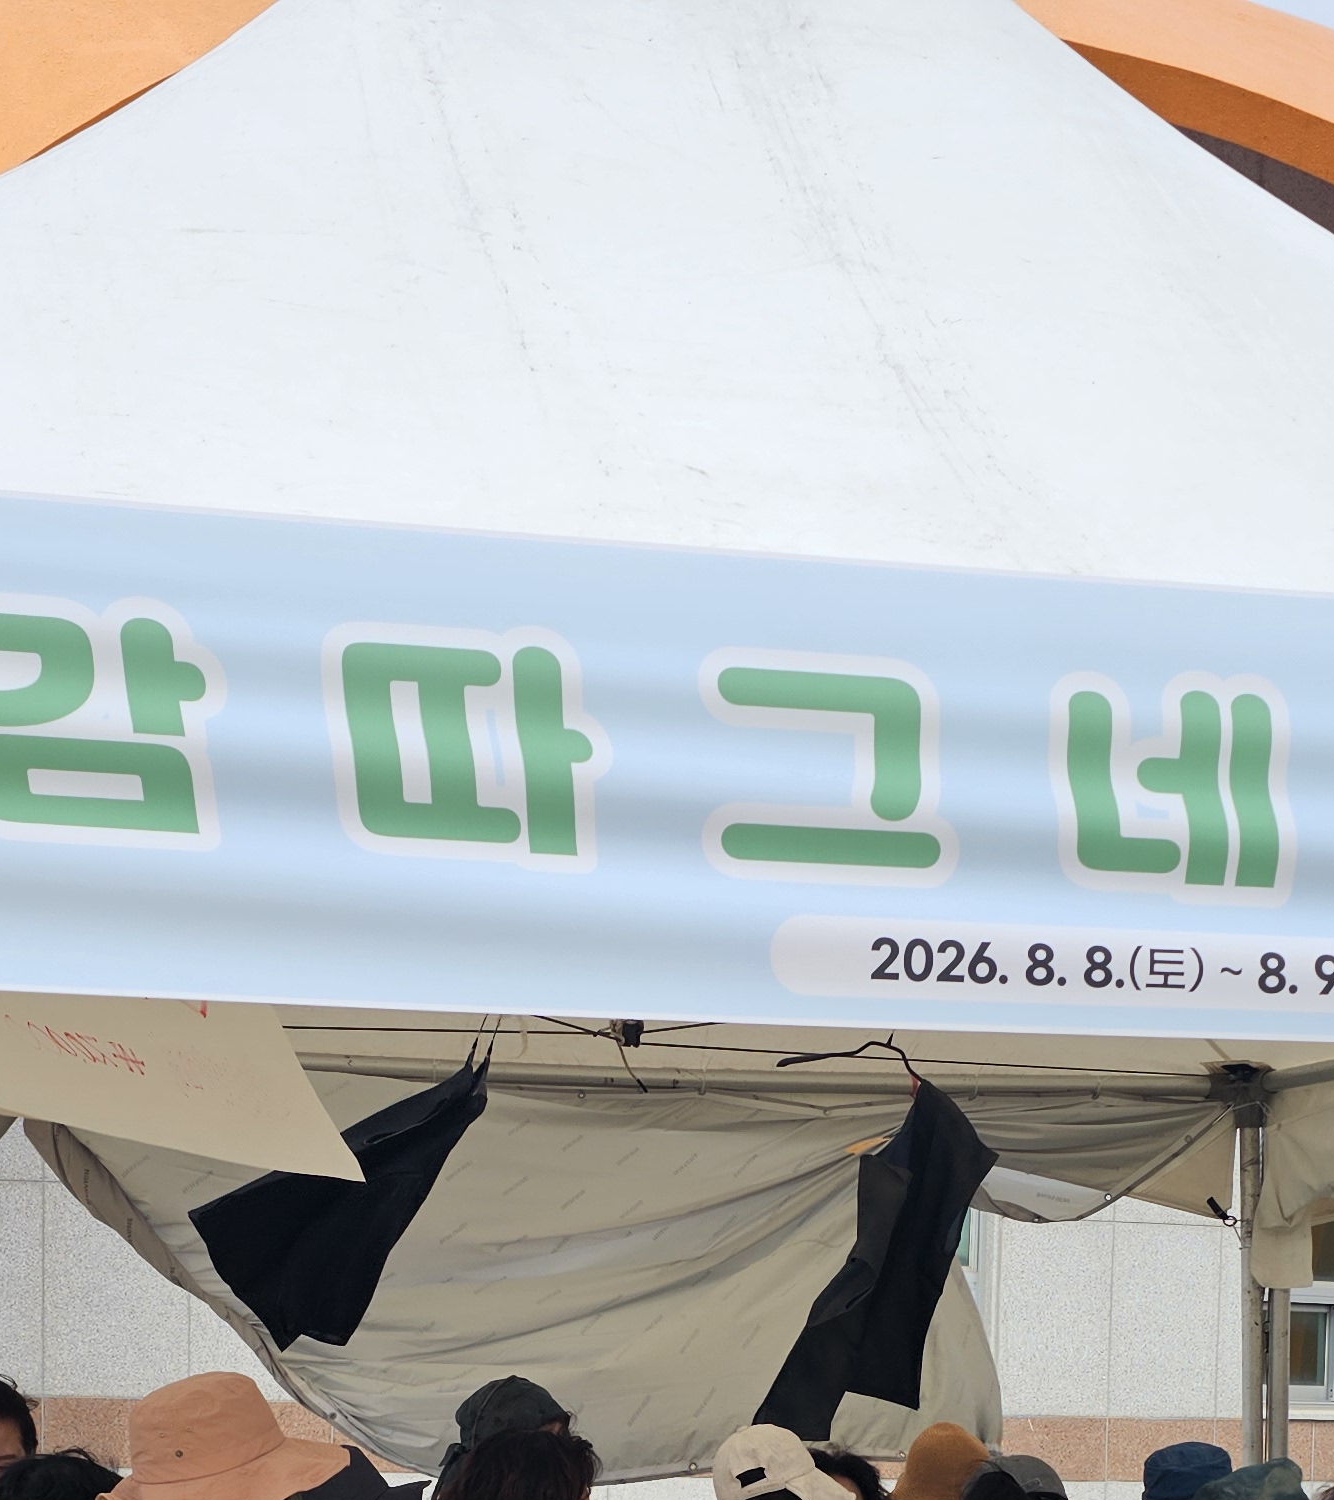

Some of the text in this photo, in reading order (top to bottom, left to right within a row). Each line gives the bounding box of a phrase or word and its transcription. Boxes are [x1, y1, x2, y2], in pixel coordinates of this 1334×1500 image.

[870, 937, 1009, 985] 2026.
[1026, 943, 1067, 987] 8.
[1083, 944, 1205, 994] 8.(토)
[1257, 952, 1298, 995] 8.
